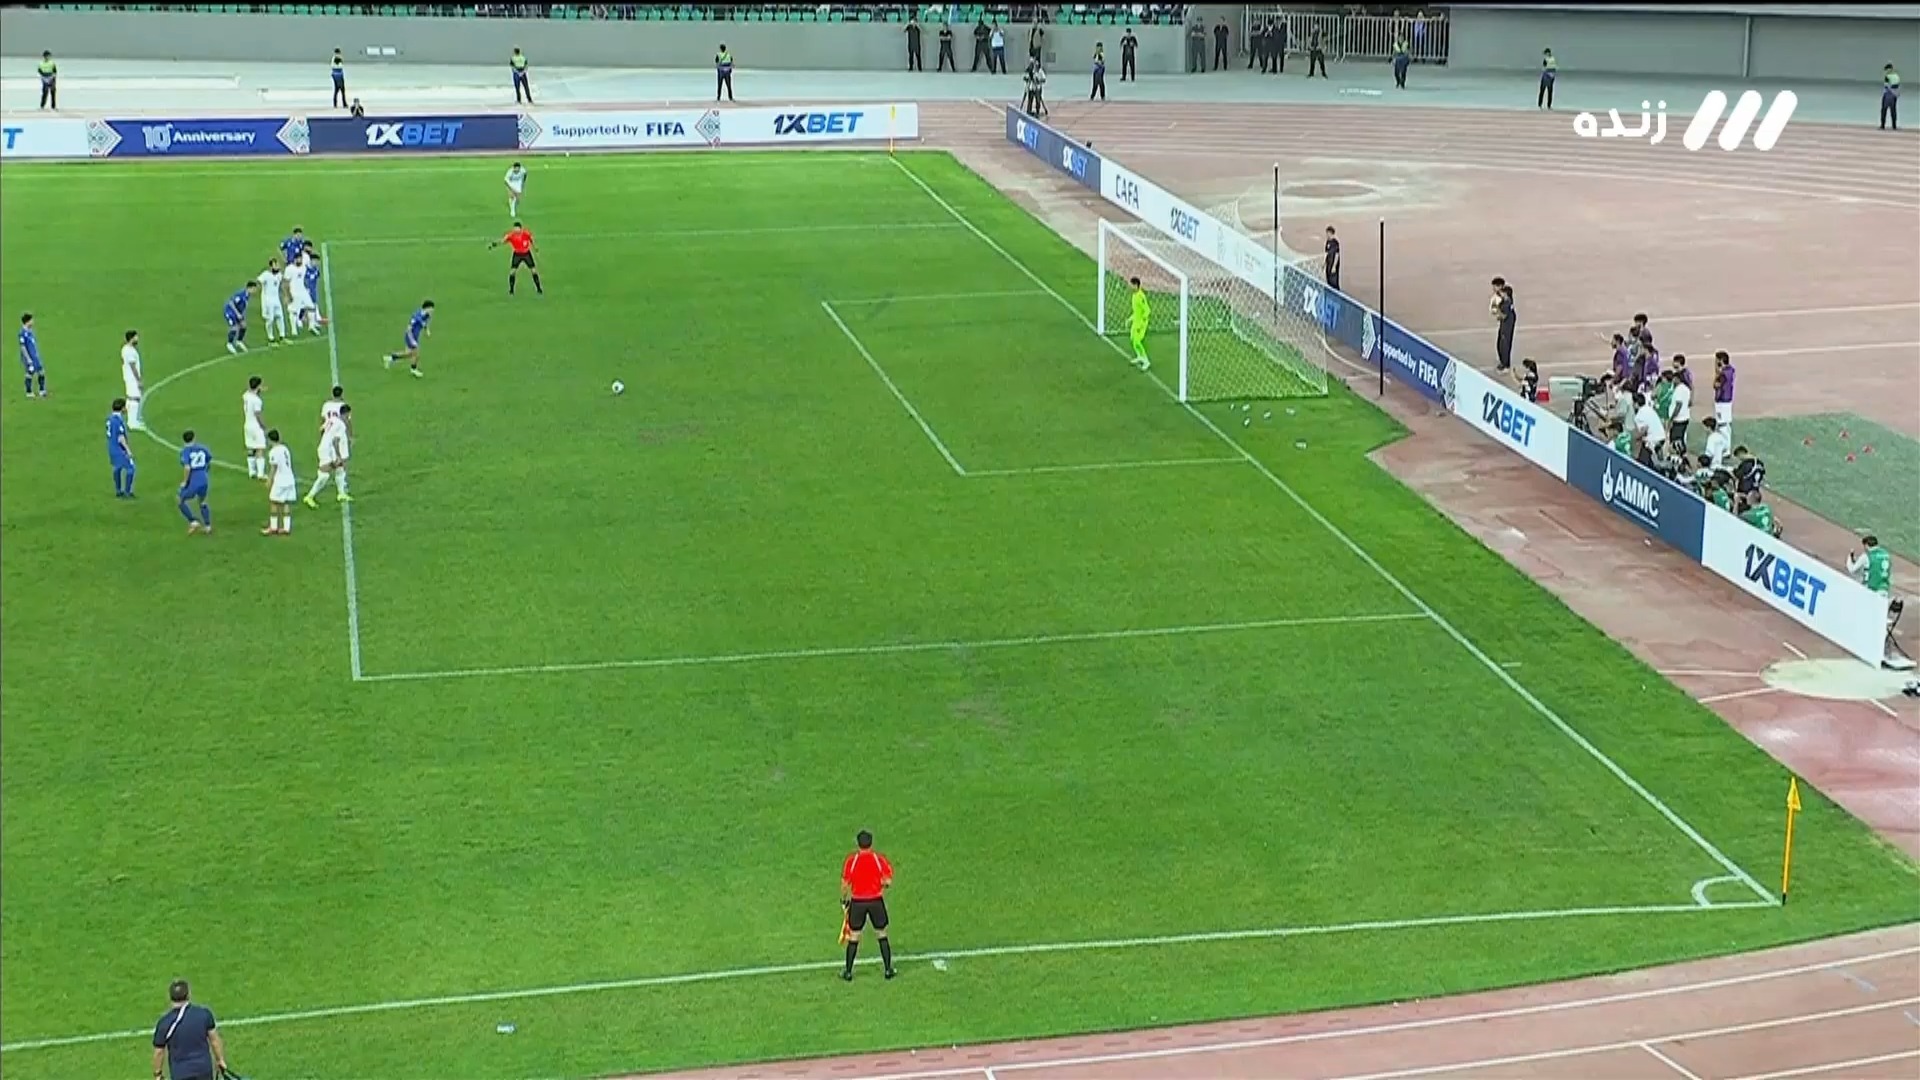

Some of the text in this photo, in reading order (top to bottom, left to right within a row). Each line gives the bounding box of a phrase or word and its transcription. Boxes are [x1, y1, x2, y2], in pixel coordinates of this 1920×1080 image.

[173, 130, 256, 144] Anniversary
[365, 122, 463, 146] 1XBET
[552, 122, 685, 137] Supported by FIFA
[774, 112, 864, 135] 1XBET
[1115, 174, 1139, 209] CAFA
[1170, 206, 1199, 242] 1XBET
[1418, 360, 1438, 389] FIFA
[1483, 391, 1536, 447] 1XBET
[1614, 470, 1659, 517] AMMC
[1745, 543, 1826, 616] 1XBET
